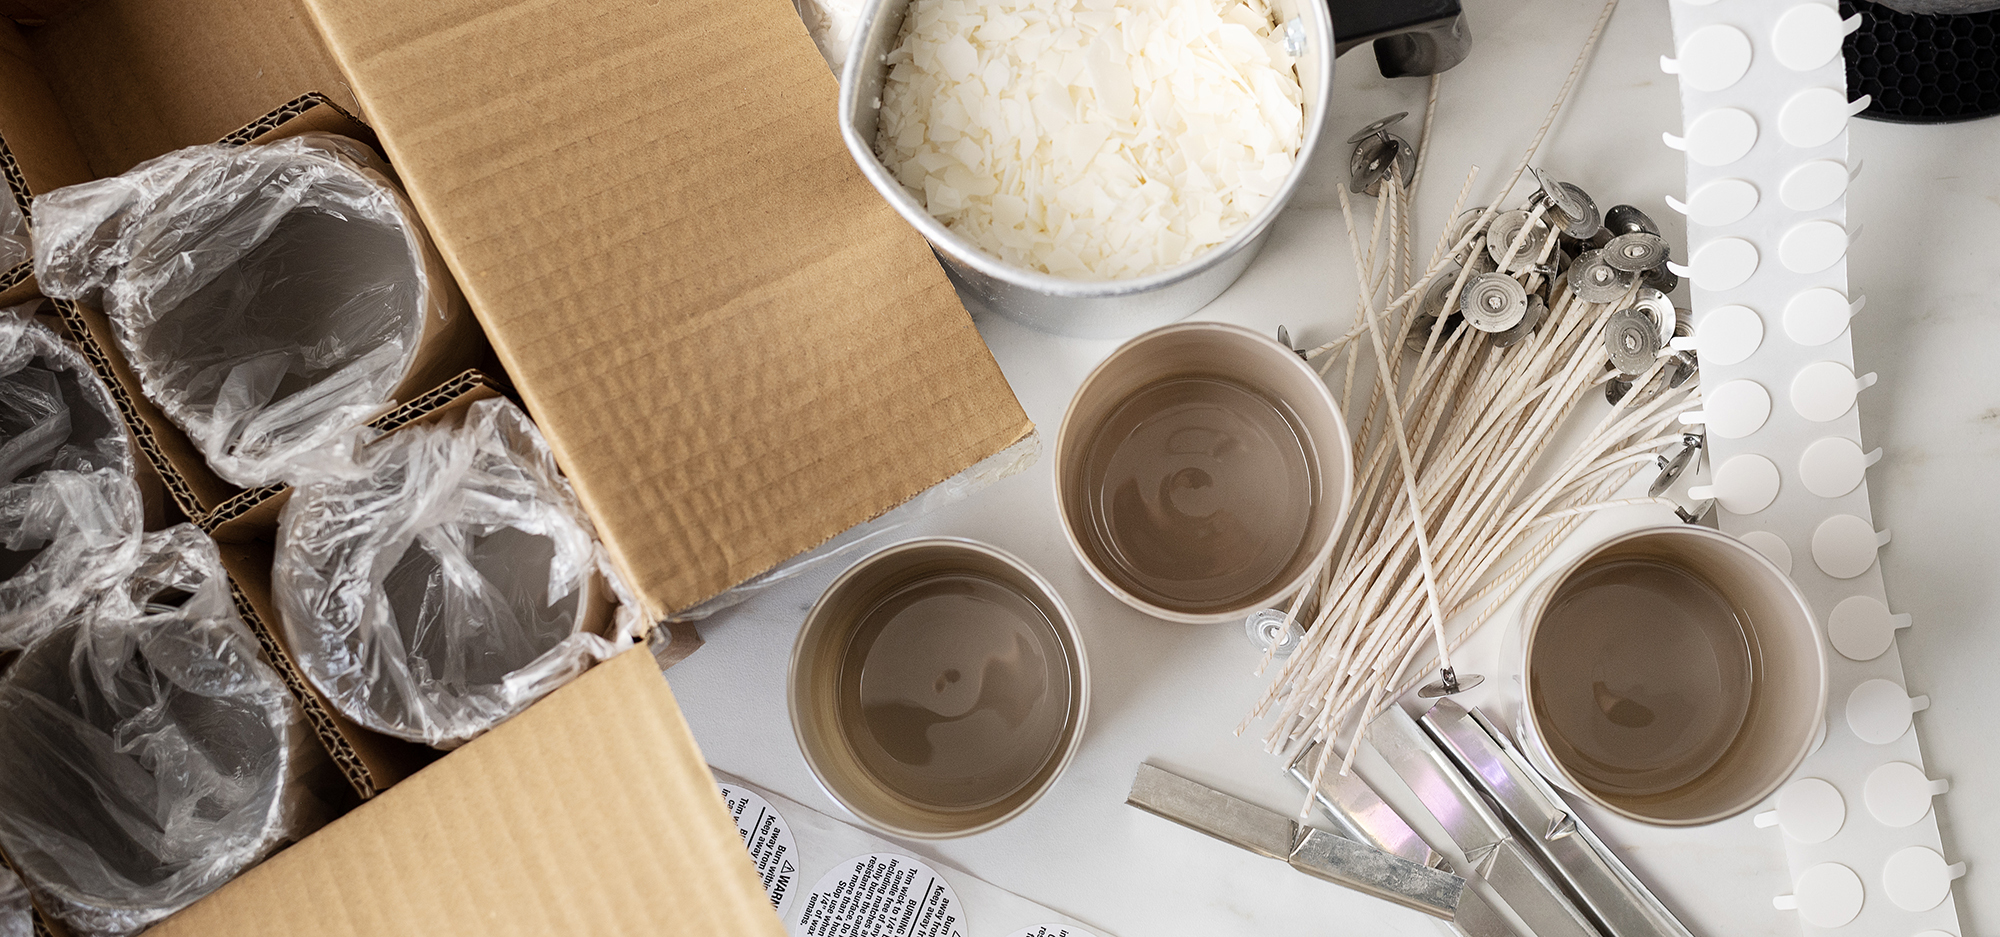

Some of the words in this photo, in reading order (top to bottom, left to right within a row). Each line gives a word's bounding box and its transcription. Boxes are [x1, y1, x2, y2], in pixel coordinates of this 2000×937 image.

[735, 798, 749, 815] Trim
[760, 815, 776, 835] Keep
[751, 836, 766, 859] away
[766, 827, 781, 850] away
[758, 850, 773, 870] from
[772, 845, 787, 865] Burn
[855, 862, 865, 874] for
[858, 856, 877, 891] resistant
[872, 863, 887, 881] Only
[877, 859, 899, 895] including
[904, 868, 918, 885] Trim
[833, 880, 847, 899] Stop
[846, 874, 859, 895] more
[865, 881, 879, 900] burn
[889, 870, 904, 896] candle
[838, 896, 851, 914] than
[845, 890, 863, 921] surface.
[882, 897, 894, 913] free
[895, 886, 908, 905] wick
[929, 885, 945, 906] Keep
[800, 893, 819, 925] remains.
[815, 909, 822, 919] of
[827, 899, 837, 914] use
[859, 901, 871, 914] the
[864, 895, 882, 929] matches
[892, 906, 901, 915] to
[935, 898, 949, 921] away
[817, 915, 831, 937] when
[849, 915, 863, 937] candl
[878, 914, 886, 924] of
[896, 899, 917, 935] BURNING
[919, 906, 934, 929] away
[941, 915, 955, 935] Burn
[807, 919, 819, 936] wax
[827, 921, 841, 937] hou
[840, 923, 851, 934] Do
[870, 923, 882, 937] any
